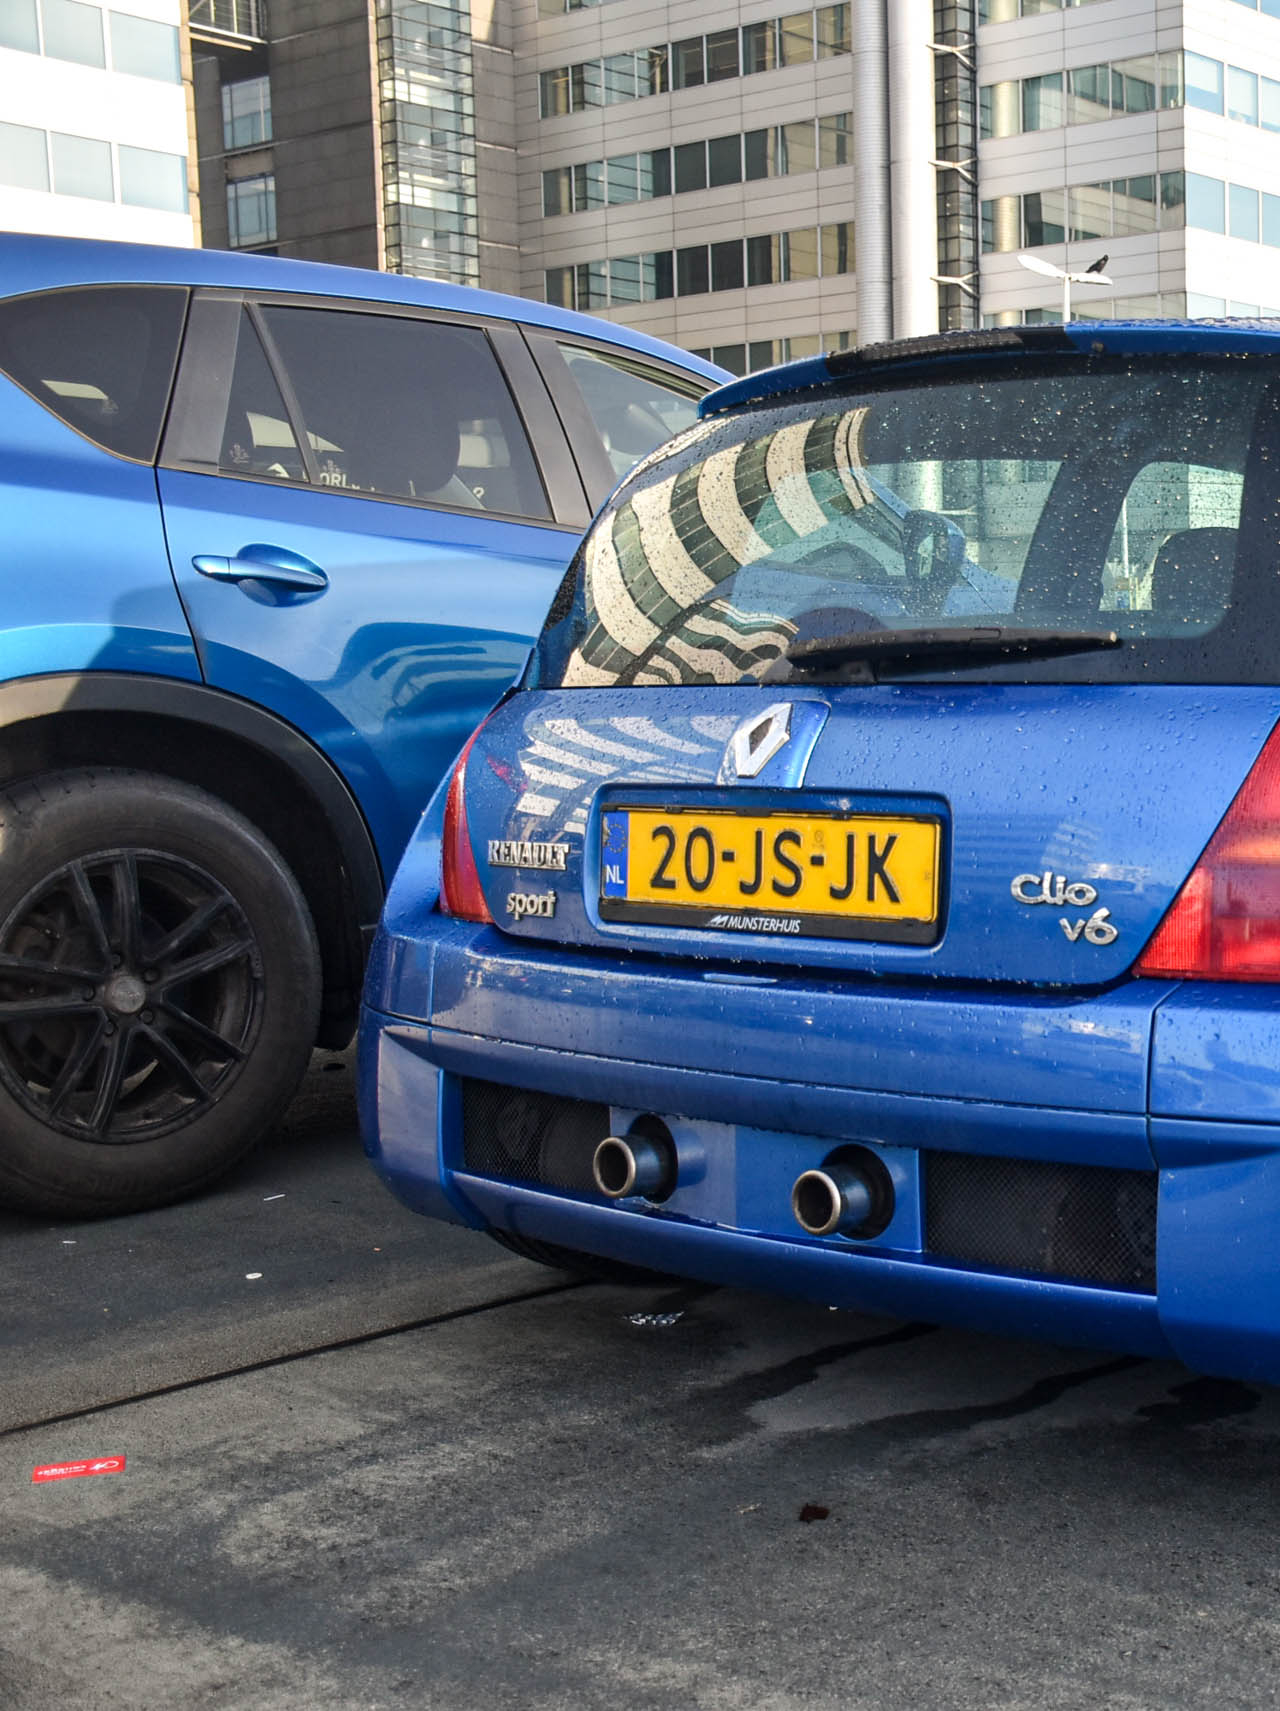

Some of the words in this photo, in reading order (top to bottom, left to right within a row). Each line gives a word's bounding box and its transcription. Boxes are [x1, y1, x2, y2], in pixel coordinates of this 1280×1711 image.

[488, 840, 569, 870] RENAULT
[650, 825, 902, 904] 20-JS-JK
[606, 865, 624, 885] NL
[506, 890, 556, 920] sport
[727, 916, 801, 933] MUNSTERHUIS
